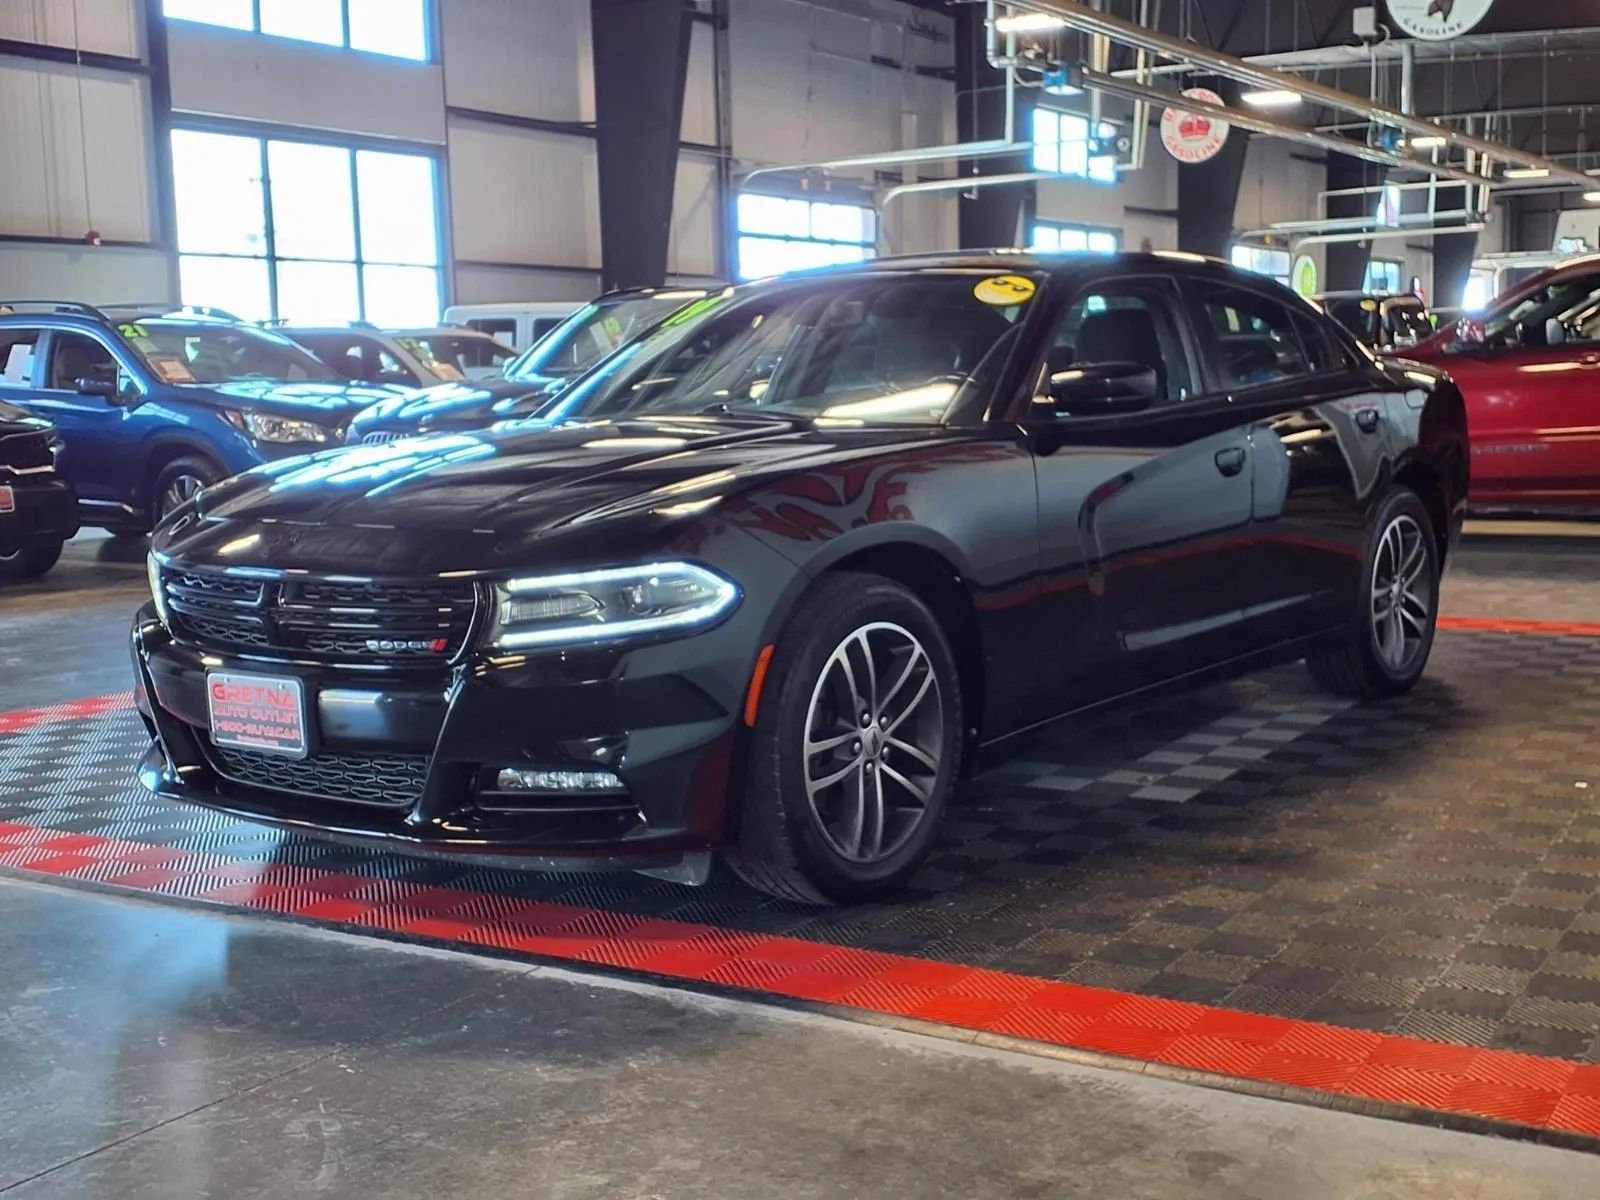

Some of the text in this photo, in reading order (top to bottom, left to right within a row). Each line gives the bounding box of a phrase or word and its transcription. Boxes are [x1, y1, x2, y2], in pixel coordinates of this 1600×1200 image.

[1403, 18, 1464, 36] GASOLINE
[1167, 136, 1221, 158] GASOLINE
[118, 324, 149, 338] 21
[366, 639, 434, 651] DODGE
[212, 682, 297, 709] GRETNA
